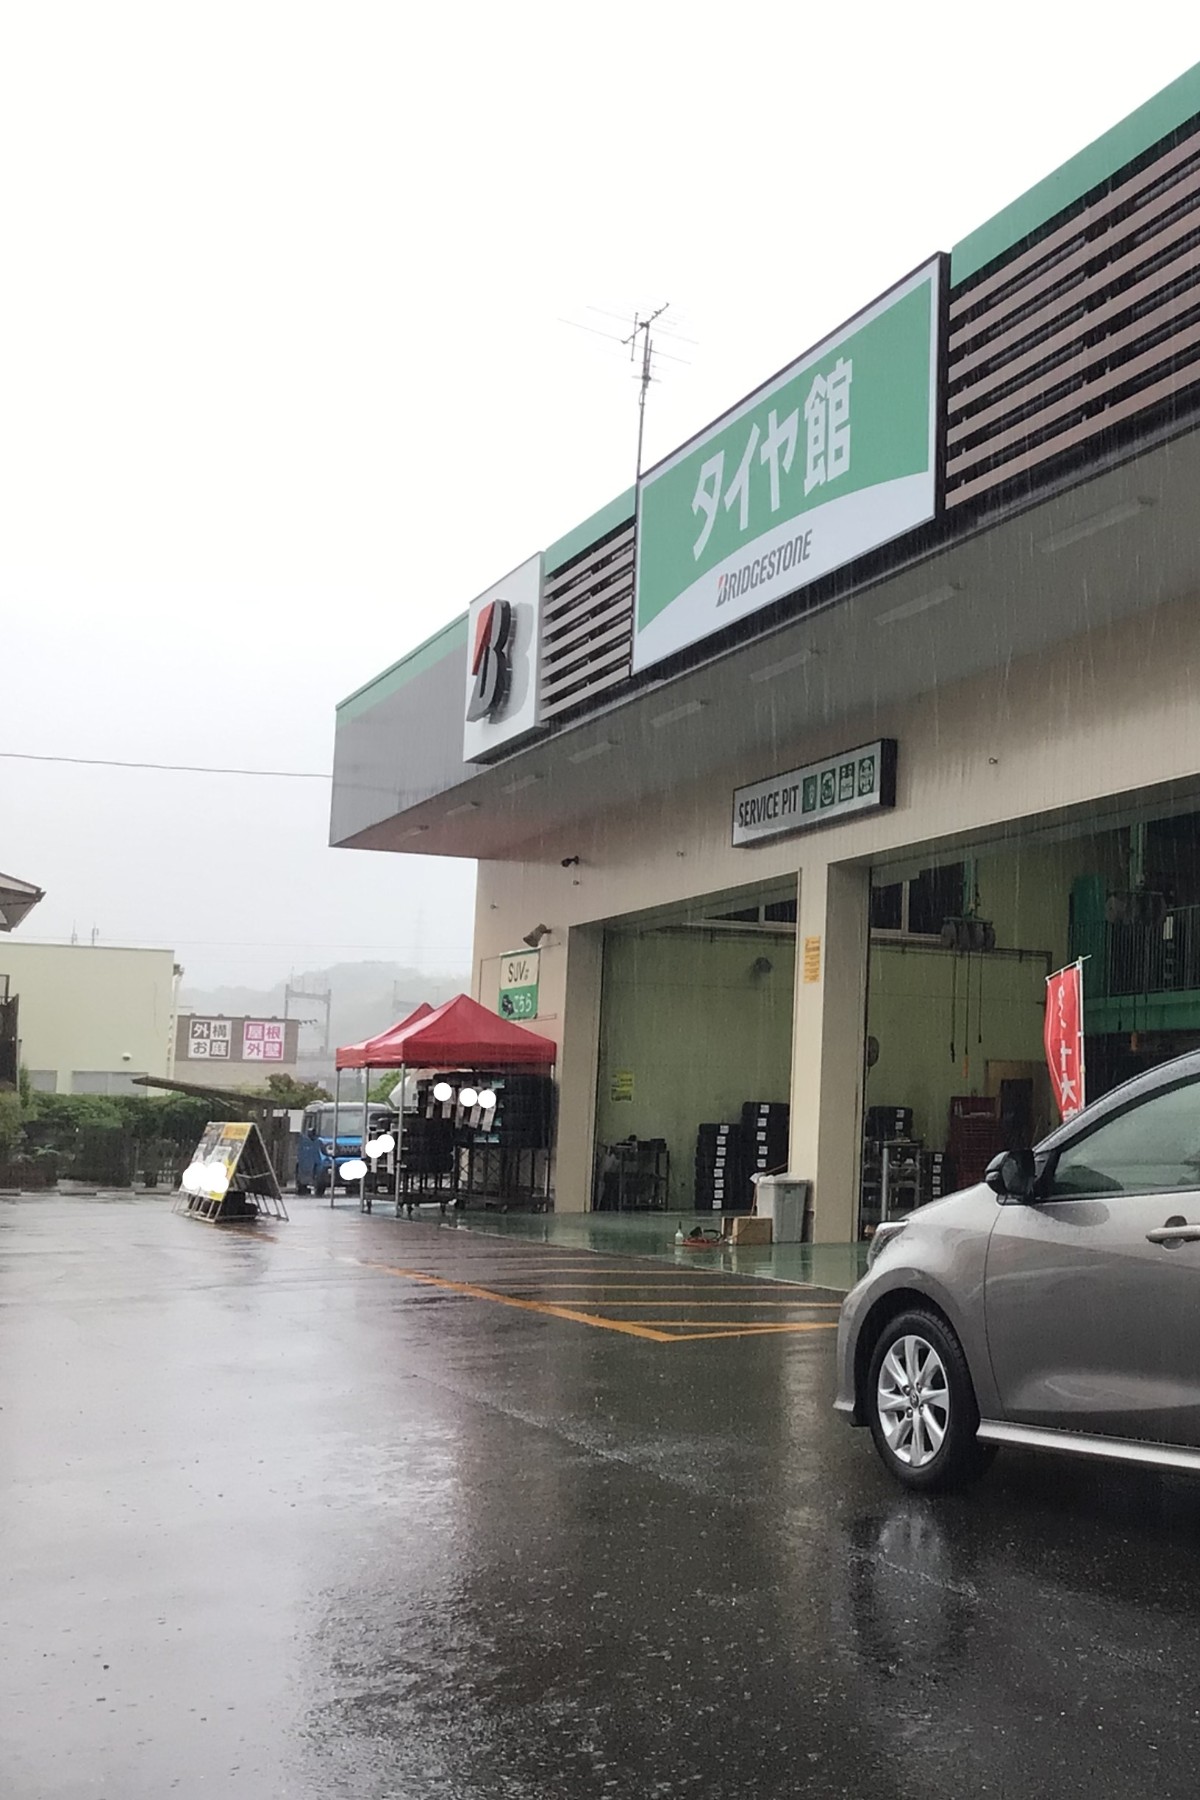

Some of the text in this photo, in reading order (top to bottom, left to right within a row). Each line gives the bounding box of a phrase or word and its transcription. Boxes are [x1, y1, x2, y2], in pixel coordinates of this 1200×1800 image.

[692, 357, 852, 562] タイヤ館
[716, 529, 813, 608] BRIDGESTONE
[739, 785, 799, 828] SERVICE PIT
